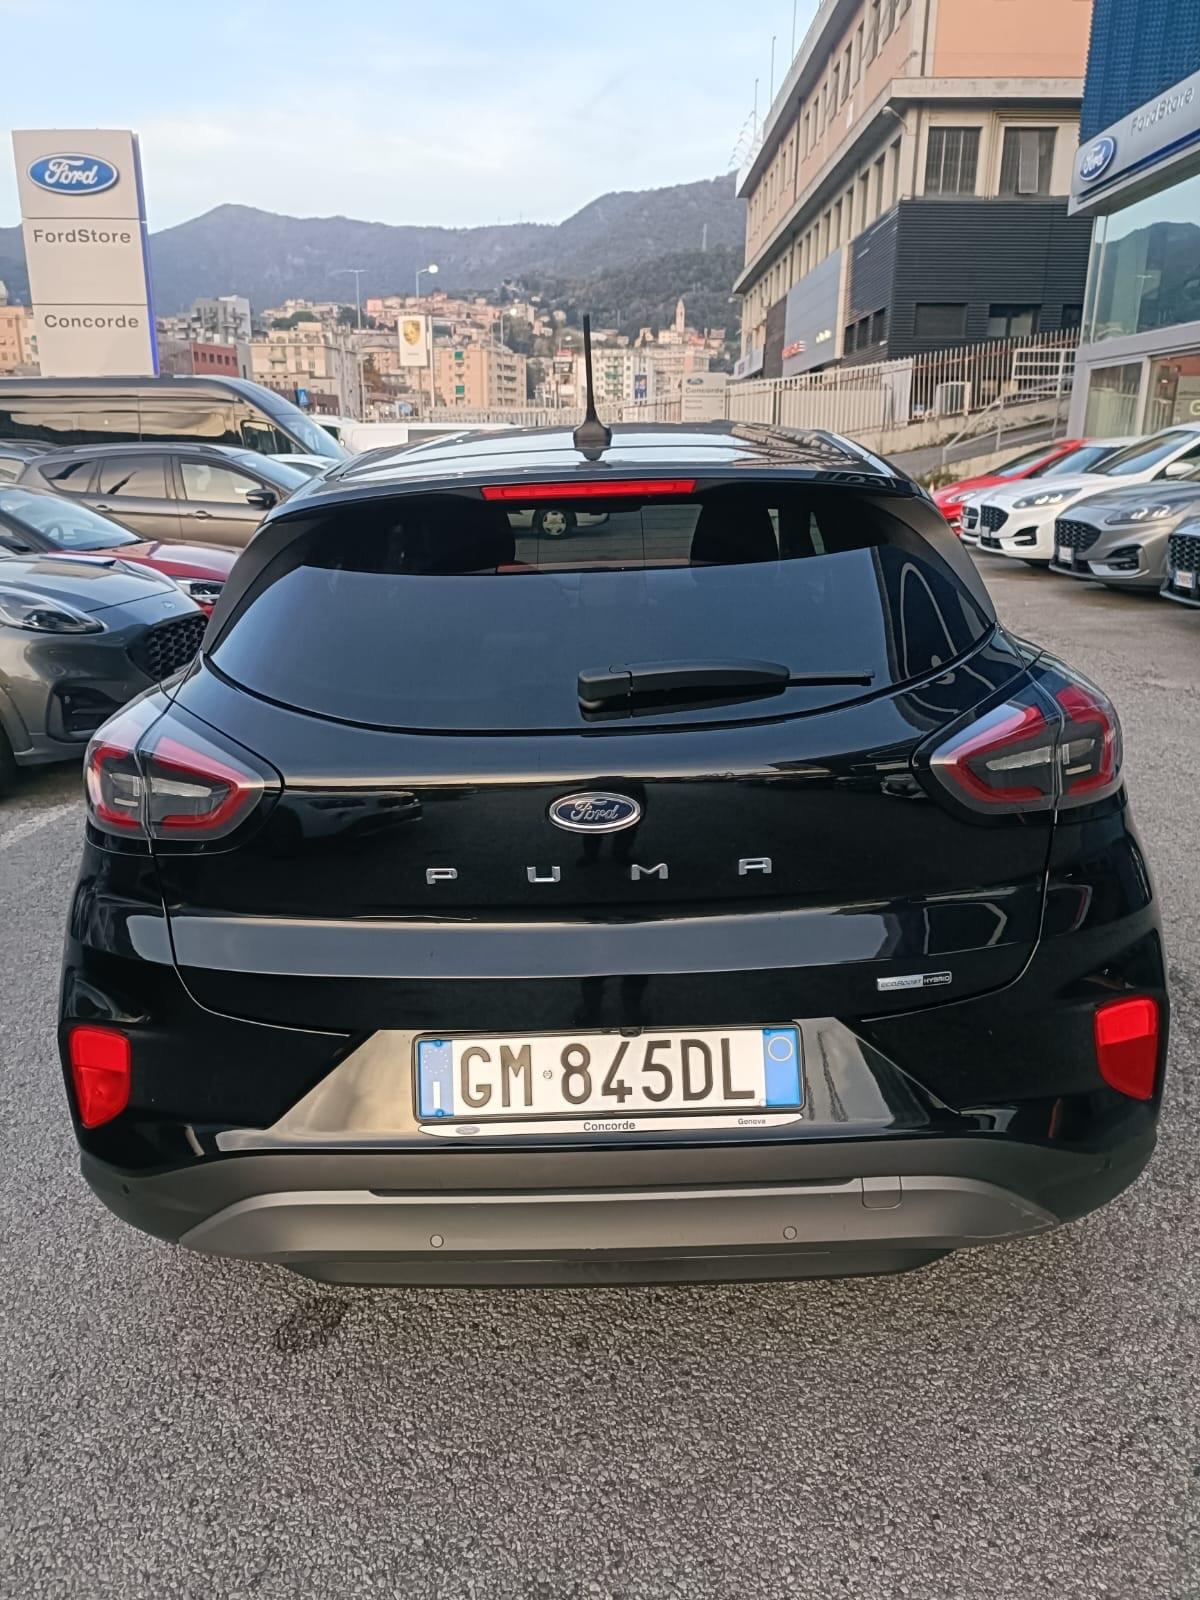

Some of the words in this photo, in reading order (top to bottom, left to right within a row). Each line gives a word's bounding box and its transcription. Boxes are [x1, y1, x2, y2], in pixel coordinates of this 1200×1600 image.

[1131, 87, 1195, 136] FordStore
[1082, 144, 1107, 175] Ford
[44, 158, 99, 185] Ford
[33, 229, 132, 244] FordStore
[44, 314, 139, 328] Concorde
[569, 799, 620, 822] Ford
[460, 1043, 533, 1108] GM
[560, 1037, 756, 1105] 845DL
[583, 1121, 636, 1132] Concorde
[737, 1117, 767, 1126] Genova
